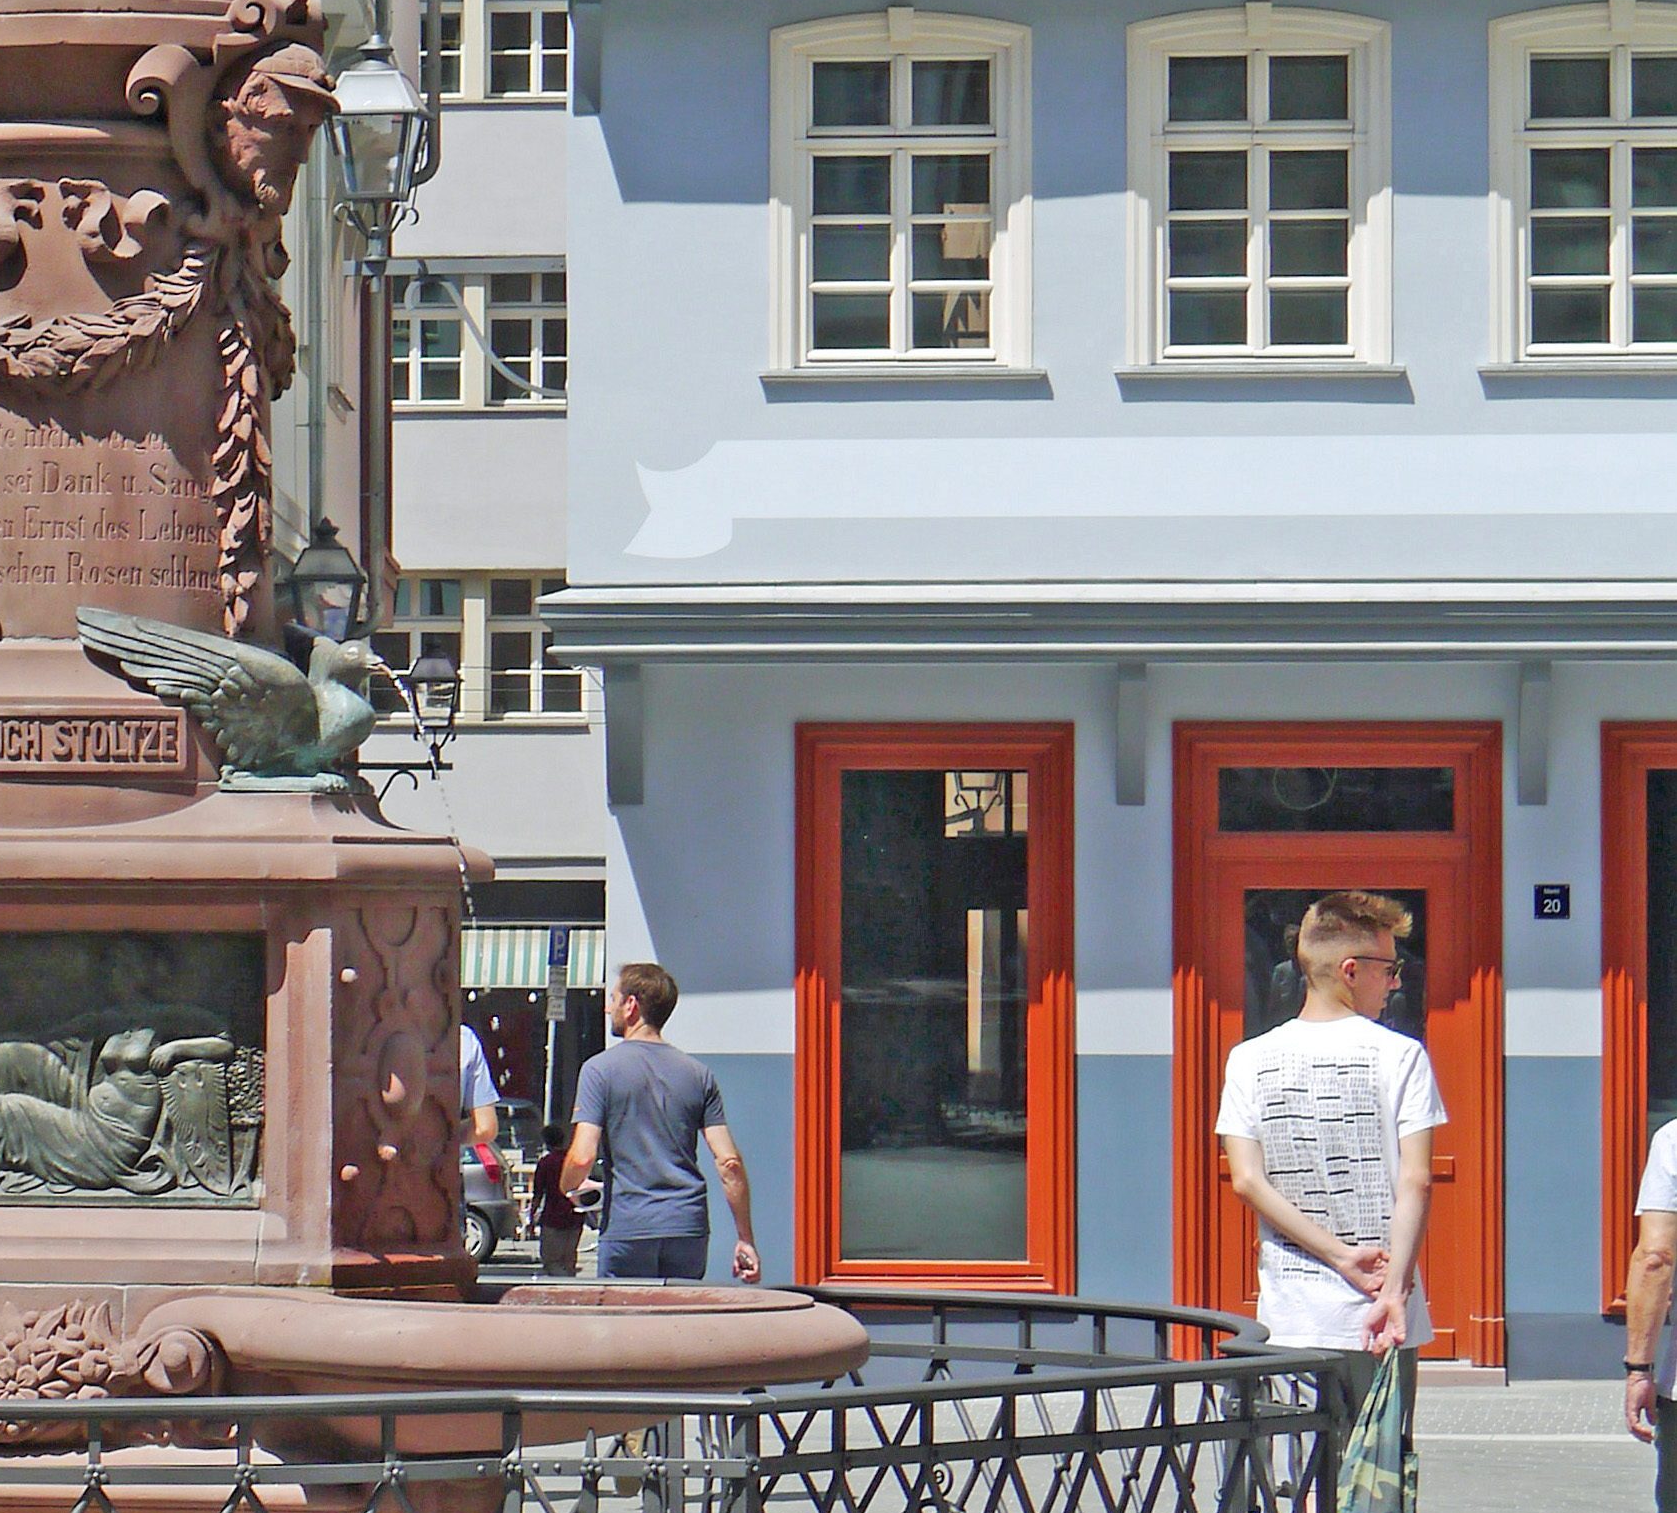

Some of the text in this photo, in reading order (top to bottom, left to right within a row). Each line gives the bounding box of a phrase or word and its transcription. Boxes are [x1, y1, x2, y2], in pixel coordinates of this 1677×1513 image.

[3, 468, 33, 495] sei
[40, 460, 113, 497] Dank
[23, 505, 86, 541] Ernst
[92, 507, 130, 542] des
[138, 508, 219, 546] Lebens
[67, 551, 144, 588] Rosen
[50, 720, 178, 763] STOLTZE
[1543, 899, 1561, 913] 20
[553, 930, 566, 961] P
